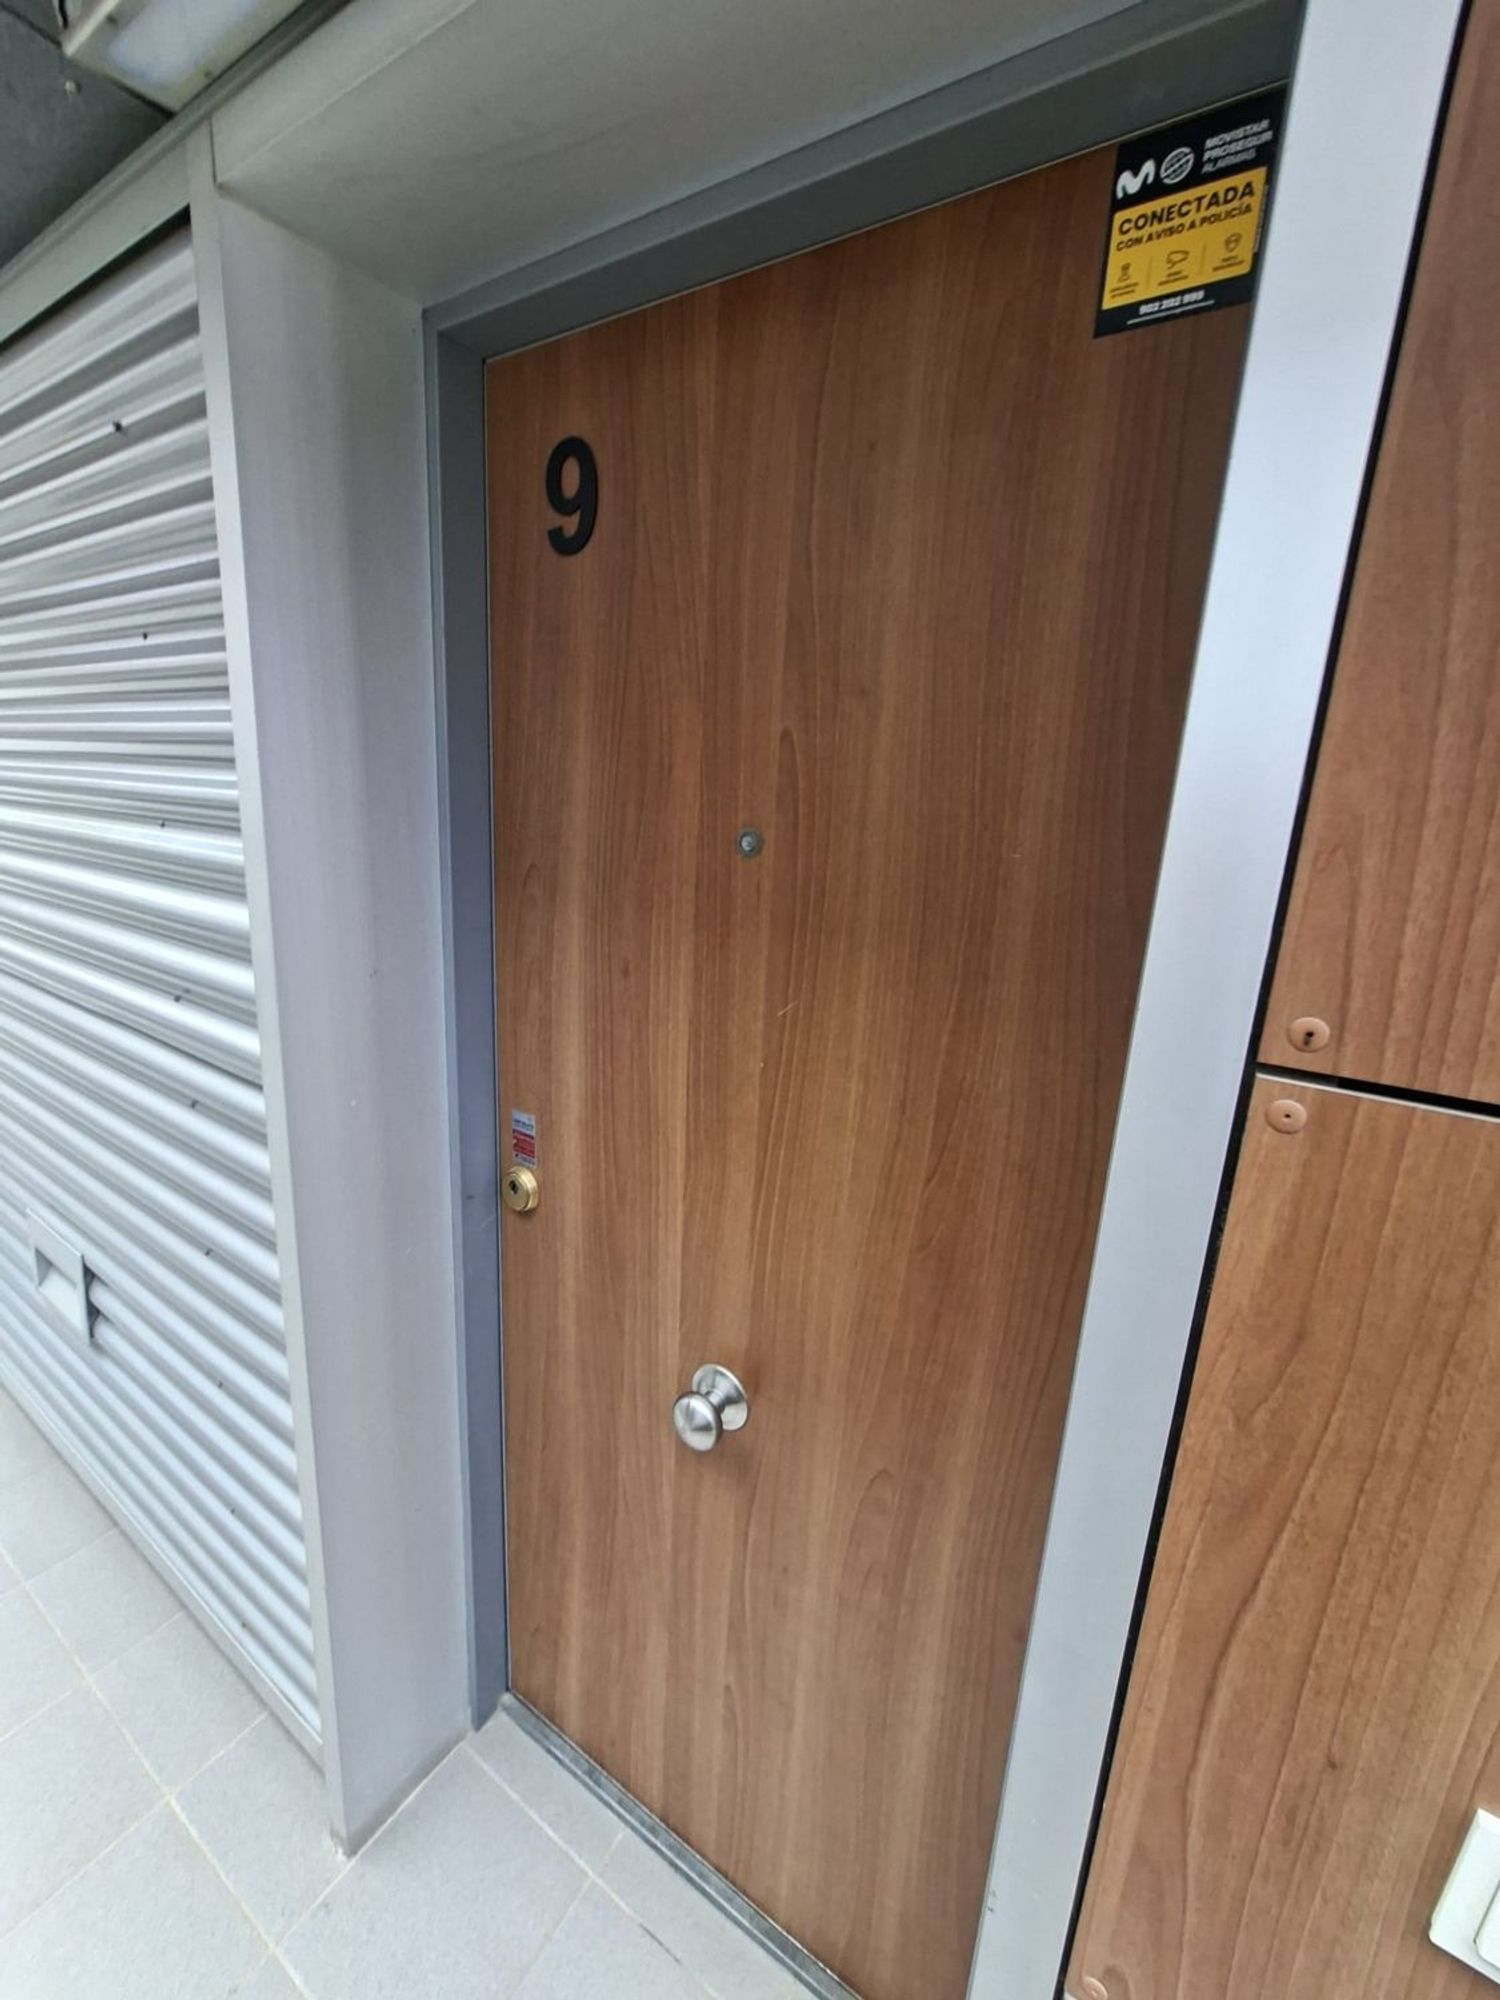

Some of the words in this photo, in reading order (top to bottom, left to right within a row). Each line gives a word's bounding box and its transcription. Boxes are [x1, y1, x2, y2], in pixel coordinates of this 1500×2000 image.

[1116, 235, 1144, 251] CON
[1145, 223, 1185, 244] AVISO
[1187, 219, 1198, 232] A
[1200, 202, 1252, 226] POLICÍA
[1118, 180, 1255, 236] CONECTADA
[545, 436, 598, 556] 9
